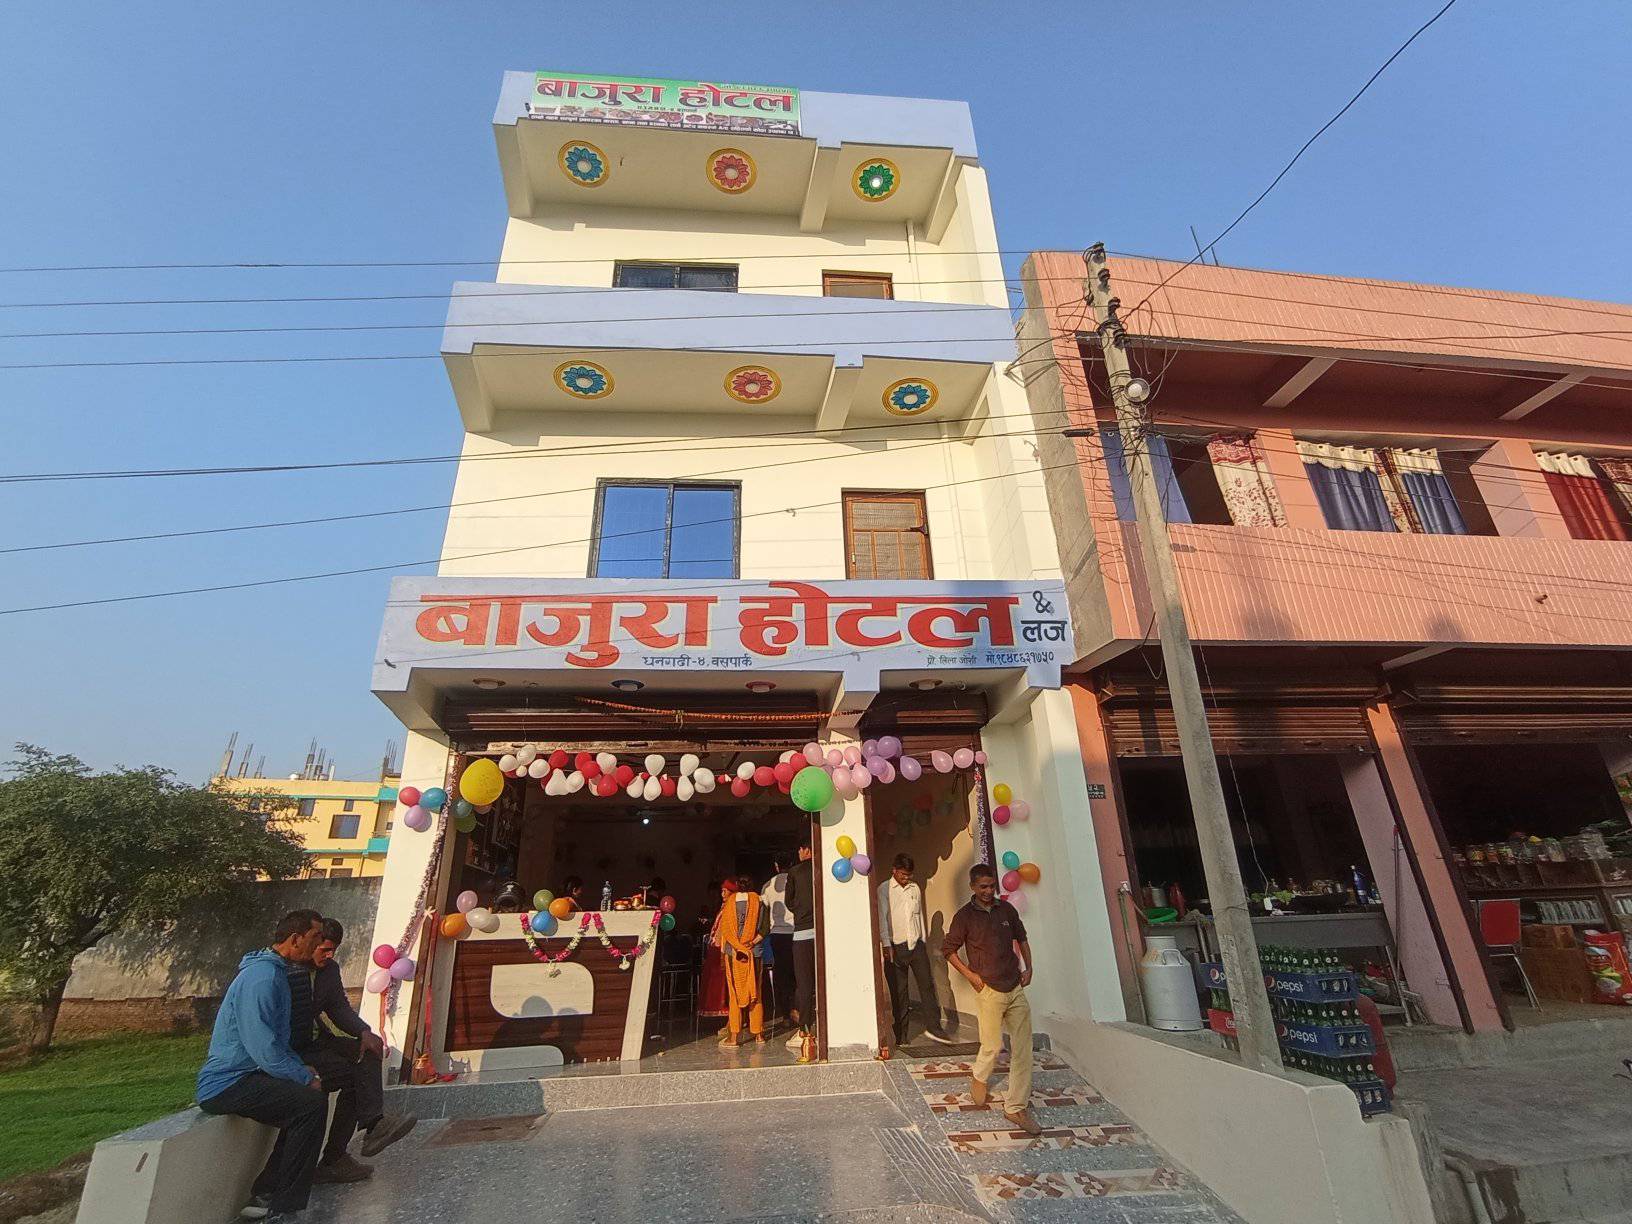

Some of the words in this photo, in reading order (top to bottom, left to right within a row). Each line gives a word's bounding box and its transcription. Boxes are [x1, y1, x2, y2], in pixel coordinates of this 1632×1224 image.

[537, 78, 666, 106] बाजुरा
[679, 83, 796, 111] होटल
[1032, 590, 1052, 614] &
[415, 594, 718, 668] बाजुरा
[738, 581, 1019, 656] होटल
[1020, 620, 1067, 642] लज
[1276, 980, 1304, 993] pepsi
[1289, 1029, 1318, 1044] pepsi
